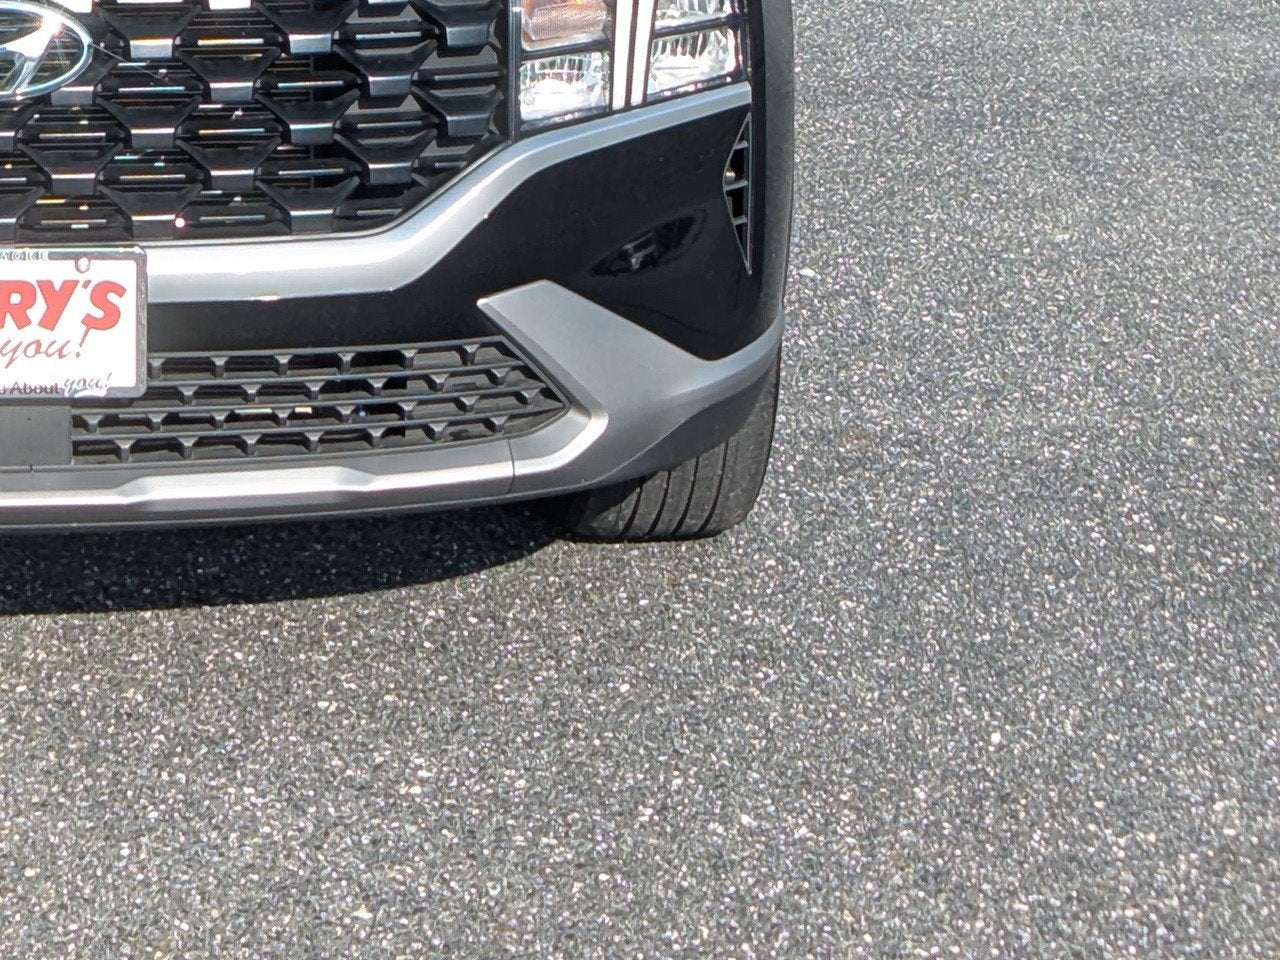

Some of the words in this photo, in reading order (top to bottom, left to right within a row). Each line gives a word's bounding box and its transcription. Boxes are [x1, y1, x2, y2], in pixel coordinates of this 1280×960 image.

[0, 327, 88, 369] you!
[9, 380, 60, 395] About
[63, 371, 113, 396] you!
